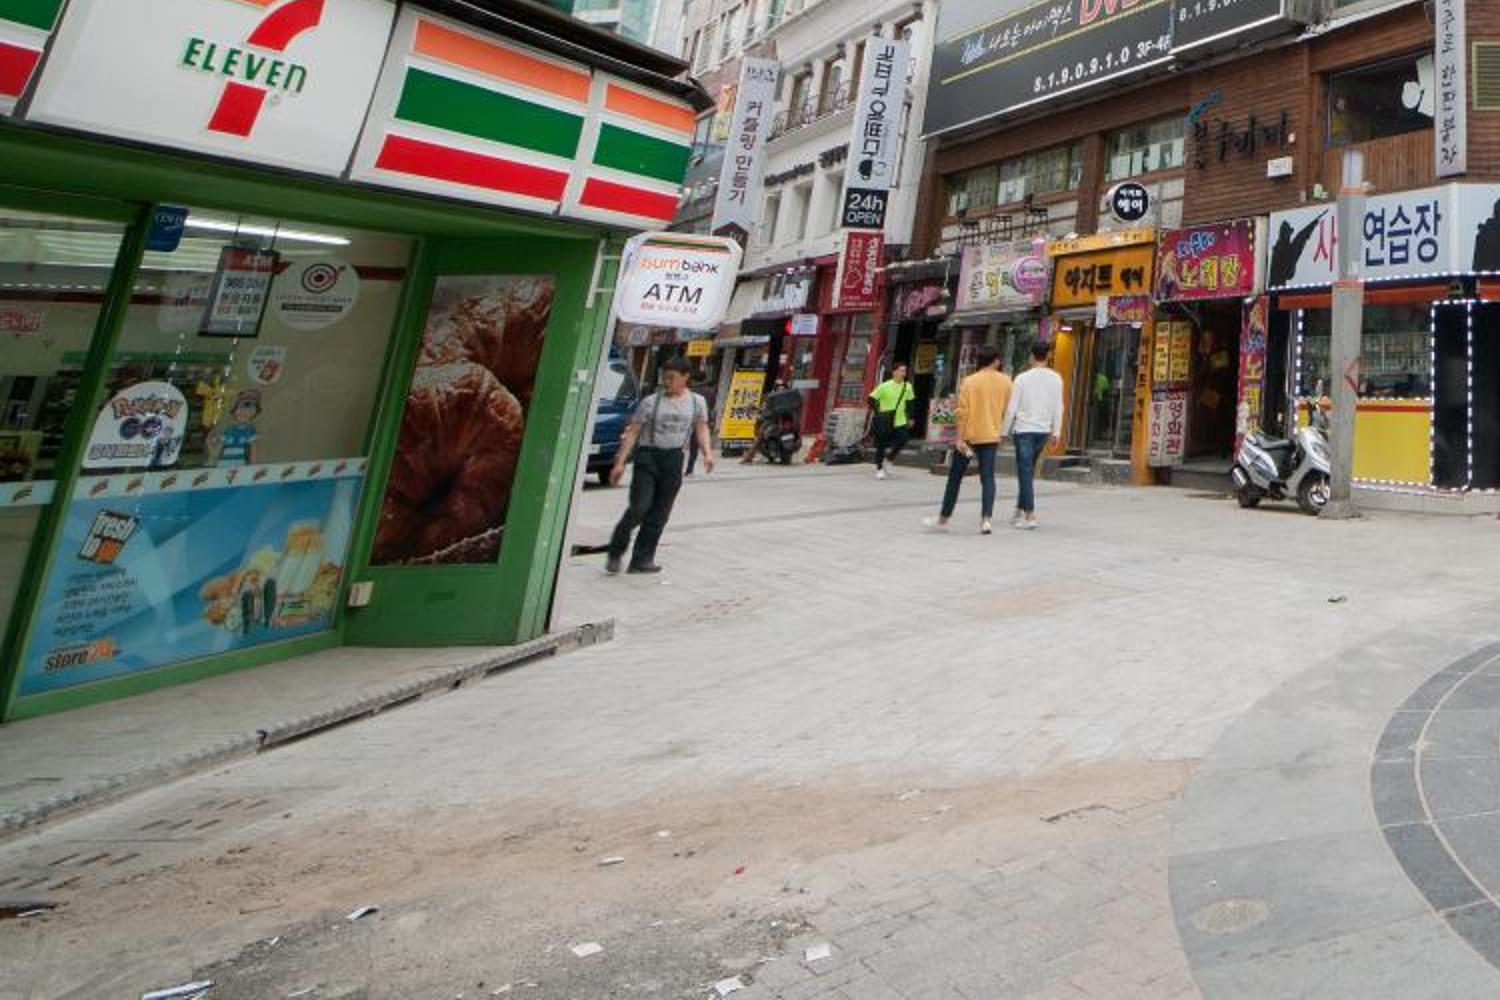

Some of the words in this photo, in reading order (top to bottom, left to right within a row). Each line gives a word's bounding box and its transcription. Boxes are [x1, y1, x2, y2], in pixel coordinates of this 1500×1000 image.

[848, 193, 884, 213] 24h
[846, 209, 883, 226] OPEN
[1312, 199, 1442, 272] 사연습장
[643, 283, 704, 307] ATM
